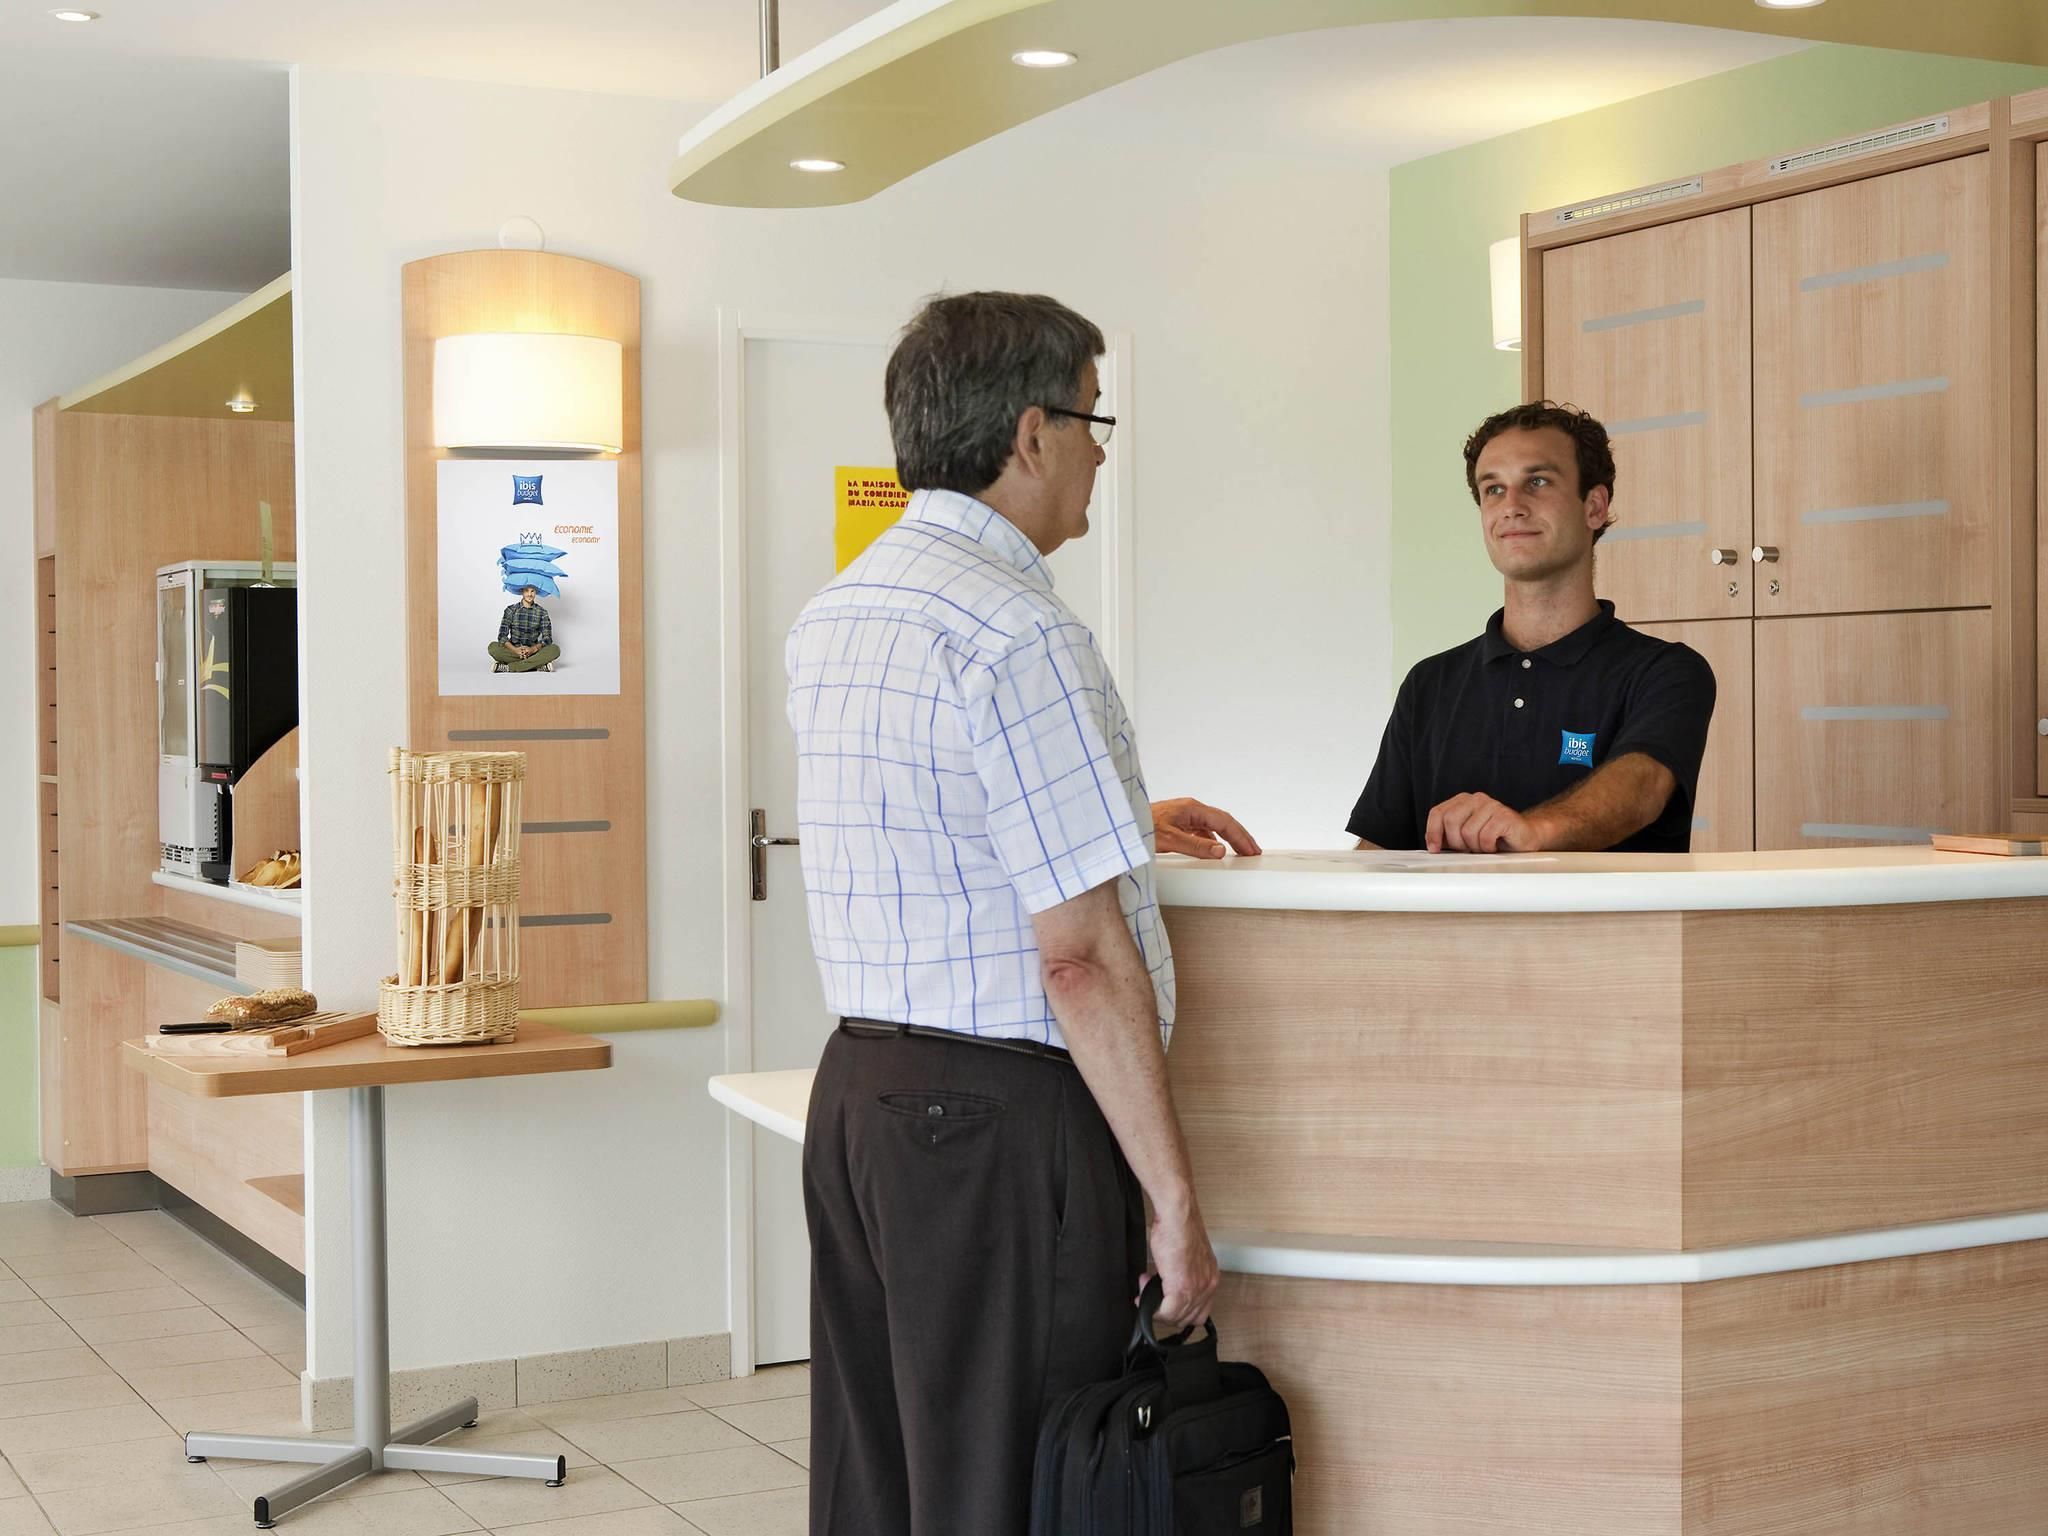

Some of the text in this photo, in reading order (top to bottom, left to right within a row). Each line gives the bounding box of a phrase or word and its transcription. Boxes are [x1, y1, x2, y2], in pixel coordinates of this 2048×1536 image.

[520, 480, 536, 490] ibis
[517, 489, 539, 498] budget
[864, 490, 907, 498] COMEDIEN
[1568, 737, 1587, 750] ibis
[1564, 747, 1590, 757] budget
